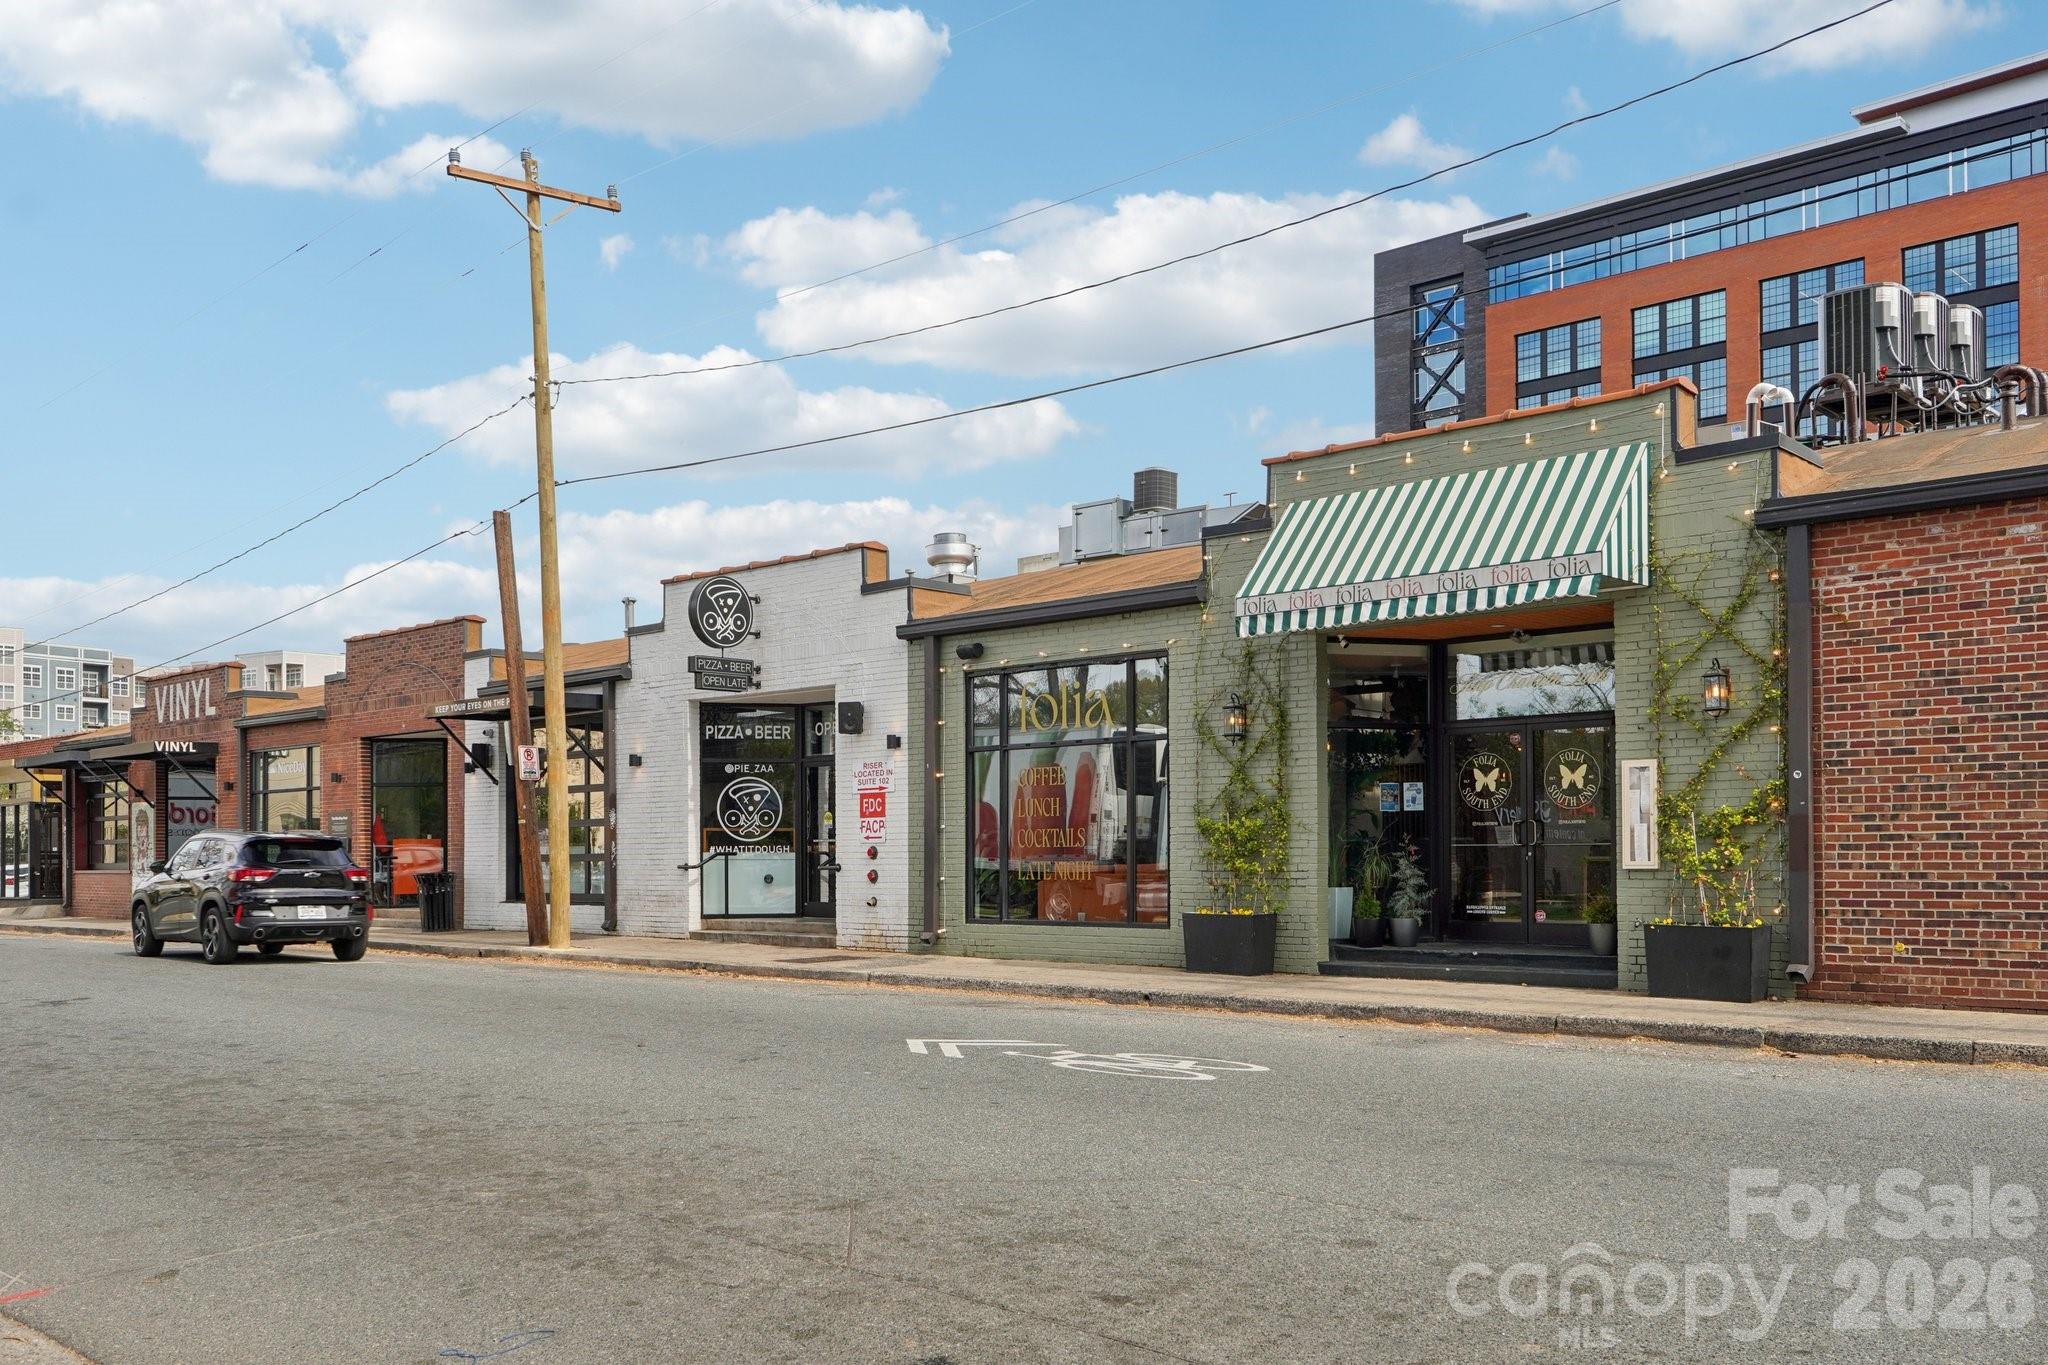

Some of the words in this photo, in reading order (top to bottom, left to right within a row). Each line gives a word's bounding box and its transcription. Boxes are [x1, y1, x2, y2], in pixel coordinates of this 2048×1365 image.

[1243, 597, 1278, 615] folia
[1288, 592, 1324, 611] folia
[1336, 584, 1373, 604] folia
[1385, 579, 1425, 599] folia
[1436, 572, 1477, 593] folia
[1491, 564, 1533, 586] folia
[1547, 557, 1592, 579] folia
[698, 659, 723, 670] PIZZA
[730, 662, 752, 673] BEER
[703, 676, 726, 686] OPEN
[727, 678, 747, 688] LATE
[154, 677, 217, 724] VINYL
[434, 704, 449, 714] KEEP
[450, 702, 466, 712] YOUR
[467, 701, 482, 710] EYES
[483, 699, 493, 708] ON
[493, 698, 506, 707] THE
[1019, 678, 1116, 733] folia
[705, 725, 744, 740] PIZZA
[754, 725, 792, 740] BEER
[154, 740, 197, 753] VINYL
[1473, 755, 1498, 768] FOLIA
[1559, 750, 1585, 763] FOLIA
[863, 761, 883, 770] RISER
[854, 769, 885, 778] LOCATED
[1017, 766, 1067, 788] COFFEE
[857, 778, 877, 786] SUITE
[878, 777, 890, 785] 102
[1462, 787, 1489, 809] SOUTH
[1491, 787, 1508, 806] END
[1548, 784, 1577, 807] SOUTH
[1578, 784, 1597, 803] END
[863, 798, 883, 812] FDC
[1017, 797, 1060, 818] LUNCH
[860, 820, 885, 834] FACP
[1017, 827, 1086, 848] COCKTAILS
[709, 845, 790, 854] #WHATITDOUGH
[1018, 861, 1053, 881] LATE
[1054, 861, 1094, 881] NIGHT
